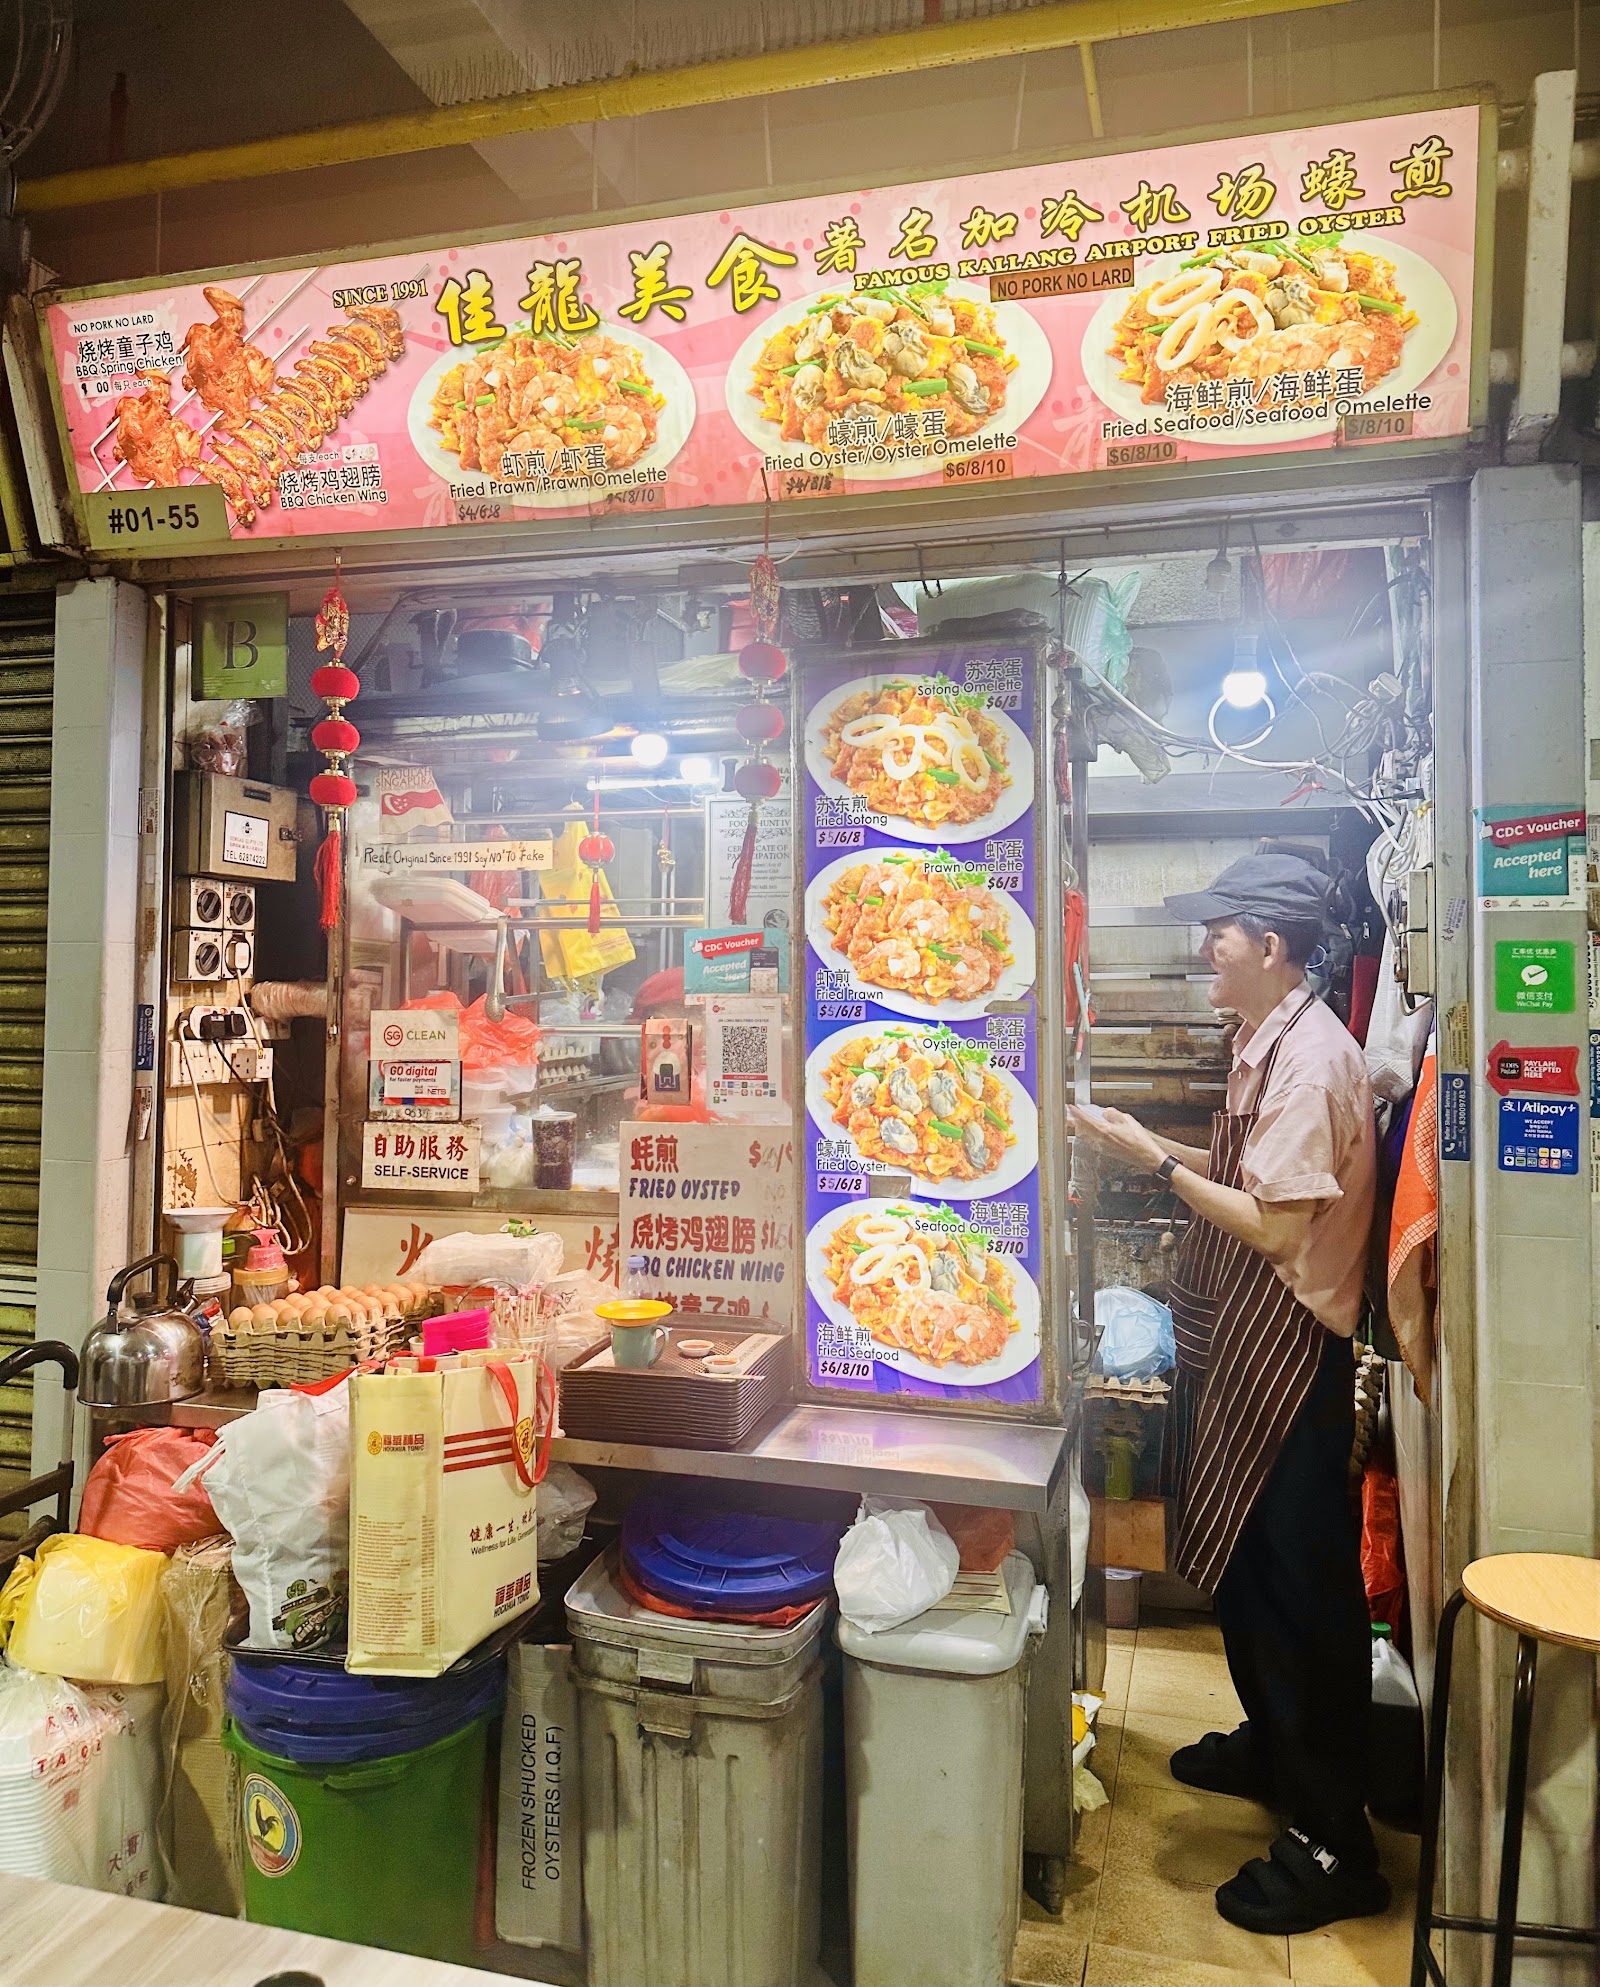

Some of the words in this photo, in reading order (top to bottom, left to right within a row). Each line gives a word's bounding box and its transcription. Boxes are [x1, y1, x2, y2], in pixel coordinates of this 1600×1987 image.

[855, 263, 949, 291] FAMOUS
[960, 247, 1076, 279] KALLANG
[1086, 232, 1199, 263] AIRPORT
[1209, 219, 1289, 246] FRIED
[1300, 206, 1405, 235] OYSTER
[436, 233, 798, 347] 佳龍美食
[997, 281, 1018, 297] NO
[1022, 275, 1063, 294] PORK
[1067, 272, 1088, 290] NO
[1093, 266, 1132, 286] LARD
[333, 284, 389, 308] SINCE
[392, 279, 428, 303] 1991
[74, 322, 88, 334] NO
[90, 318, 113, 332] PORK
[115, 317, 129, 329] NO
[131, 314, 154, 327] LARD
[78, 331, 174, 364] 烧烤童子鸡
[76, 363, 99, 377] BBQ
[101, 360, 134, 376] Spring
[135, 354, 183, 370] Chicken
[132, 377, 153, 388] each
[1165, 367, 1363, 413] 海鲜煎/海鲜蛋
[1102, 421, 1148, 440] Fried
[1153, 402, 1328, 434] Seafood/Seafood
[1335, 393, 1432, 415] Omelette
[318, 451, 340, 462] each
[502, 444, 606, 478] 虾煎/虾蛋
[764, 452, 804, 473] Fried
[808, 441, 929, 468] Oyster/Oyster
[933, 431, 1018, 455] Omelette
[1108, 444, 1174, 464] $6/8/10
[945, 459, 1006, 478] $6/8/10
[280, 464, 382, 495] 烧烤鸡翅膀
[450, 481, 486, 499] Fried
[489, 472, 593, 496] Prawn/Prawn
[595, 467, 667, 489] Omelette
[280, 495, 304, 509] BBQ
[306, 492, 355, 507] Chicken
[357, 489, 387, 505] Wing
[108, 503, 200, 534] #01-55
[221, 619, 259, 670] B
[965, 658, 1022, 680] 苏东蛋
[917, 684, 960, 697] Sotong
[963, 679, 1023, 693] Omelette
[986, 695, 1018, 709] $6/8
[375, 776, 435, 788] SINGAPURA
[381, 766, 432, 779] MAJULAH
[815, 795, 868, 814] 苏东煎
[816, 814, 844, 826] Fried
[846, 814, 888, 827] Sotong
[1495, 825, 1524, 839] CDC
[1526, 818, 1581, 834] Voucher
[393, 850, 428, 868] Original
[429, 851, 452, 864] Since
[453, 851, 473, 864] 1991
[520, 849, 545, 863] Fake
[986, 840, 1023, 859] 虾蛋
[1493, 848, 1562, 869] Accepted
[924, 862, 961, 873] Prawn
[964, 860, 1023, 872] Omelette
[1528, 865, 1563, 879] here
[987, 876, 1019, 889] $6/8
[704, 943, 722, 953] CDC
[724, 937, 759, 950] Voucher
[703, 959, 747, 975] Accepted
[816, 969, 851, 988] 虾煎
[816, 989, 844, 1000] Fried
[848, 989, 884, 1000] Prawn
[1516, 1000, 1540, 1008] WeChat
[1542, 1001, 1553, 1009] Pay
[386, 1031, 401, 1041] SG
[406, 1030, 446, 1041] CLEAN
[922, 1038, 962, 1051] Oyster
[966, 1038, 1025, 1051] Omelette
[989, 1055, 1020, 1068] $6/8
[1524, 1066, 1562, 1074] ACCEPTED
[390, 1066, 404, 1076] GO
[405, 1065, 438, 1078] digital
[427, 1088, 447, 1096] NETS
[373, 1133, 469, 1162] 自助服務
[374, 1165, 469, 1180] SELF-SERVICE
[816, 1159, 845, 1171] Fried
[848, 1159, 887, 1173] Oyster
[629, 1177, 676, 1198] FRIED
[971, 1201, 1028, 1224] 海鲜蛋
[914, 1219, 966, 1234] Seafood
[969, 1223, 1030, 1237] Omelette
[986, 1240, 1024, 1254] $8/10
[666, 1257, 735, 1281] CHICKEN
[741, 1260, 785, 1283] WING
[817, 1323, 872, 1346] 海鲜煎
[817, 1345, 847, 1358] Fried
[849, 1347, 899, 1361] Seafood
[820, 1360, 870, 1377] $6/8/10
[470, 1542, 499, 1556] Wellness
[517, 1590, 530, 1605] TONIC
[521, 1713, 536, 1809] SHUCKED
[545, 1788, 561, 1881] OYSTERS
[522, 1813, 536, 1890] FROZEN
